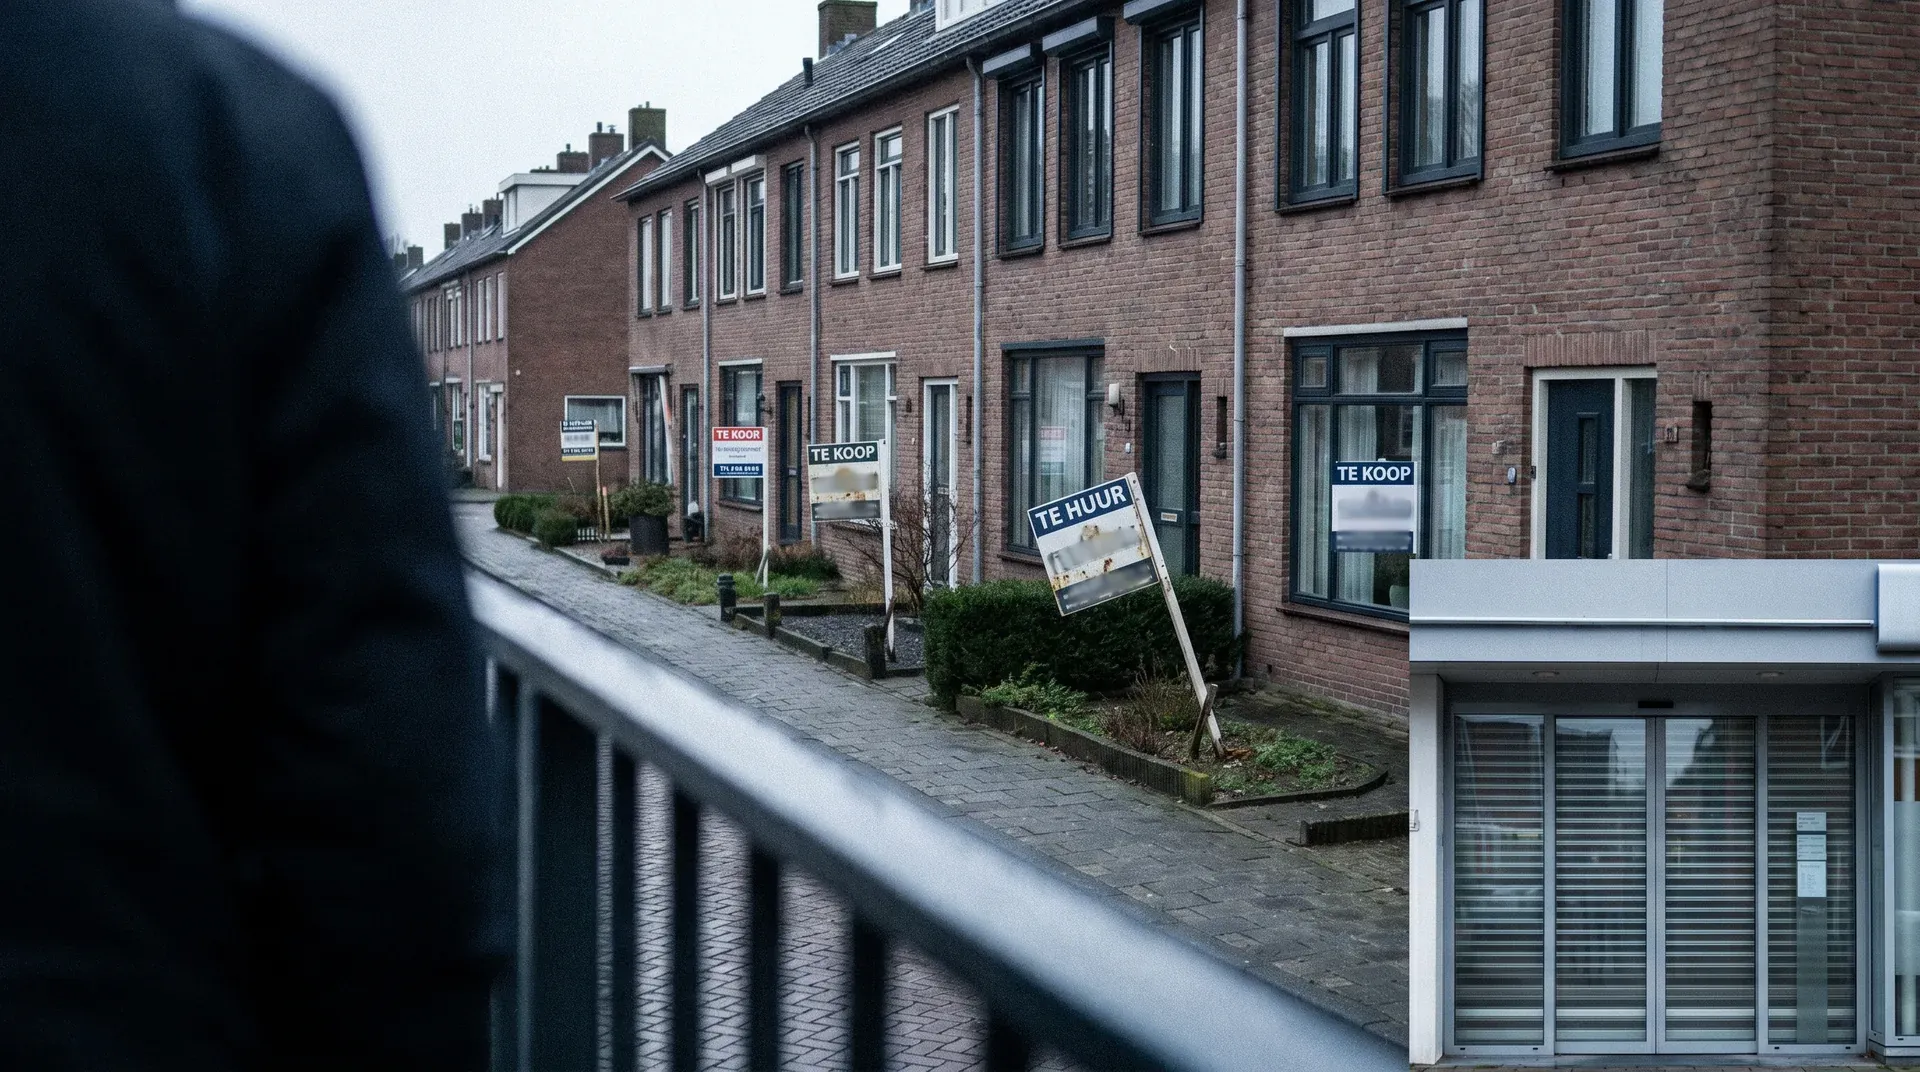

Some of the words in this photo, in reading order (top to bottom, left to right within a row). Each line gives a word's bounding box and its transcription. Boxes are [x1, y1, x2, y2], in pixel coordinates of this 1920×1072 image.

[716, 430, 729, 439] TE
[811, 448, 830, 461] TE
[833, 445, 875, 460] KOOP
[1337, 466, 1358, 481] TE
[1362, 466, 1411, 481] KOOP
[1035, 506, 1064, 529] TE
[1065, 485, 1127, 520] HUUR
